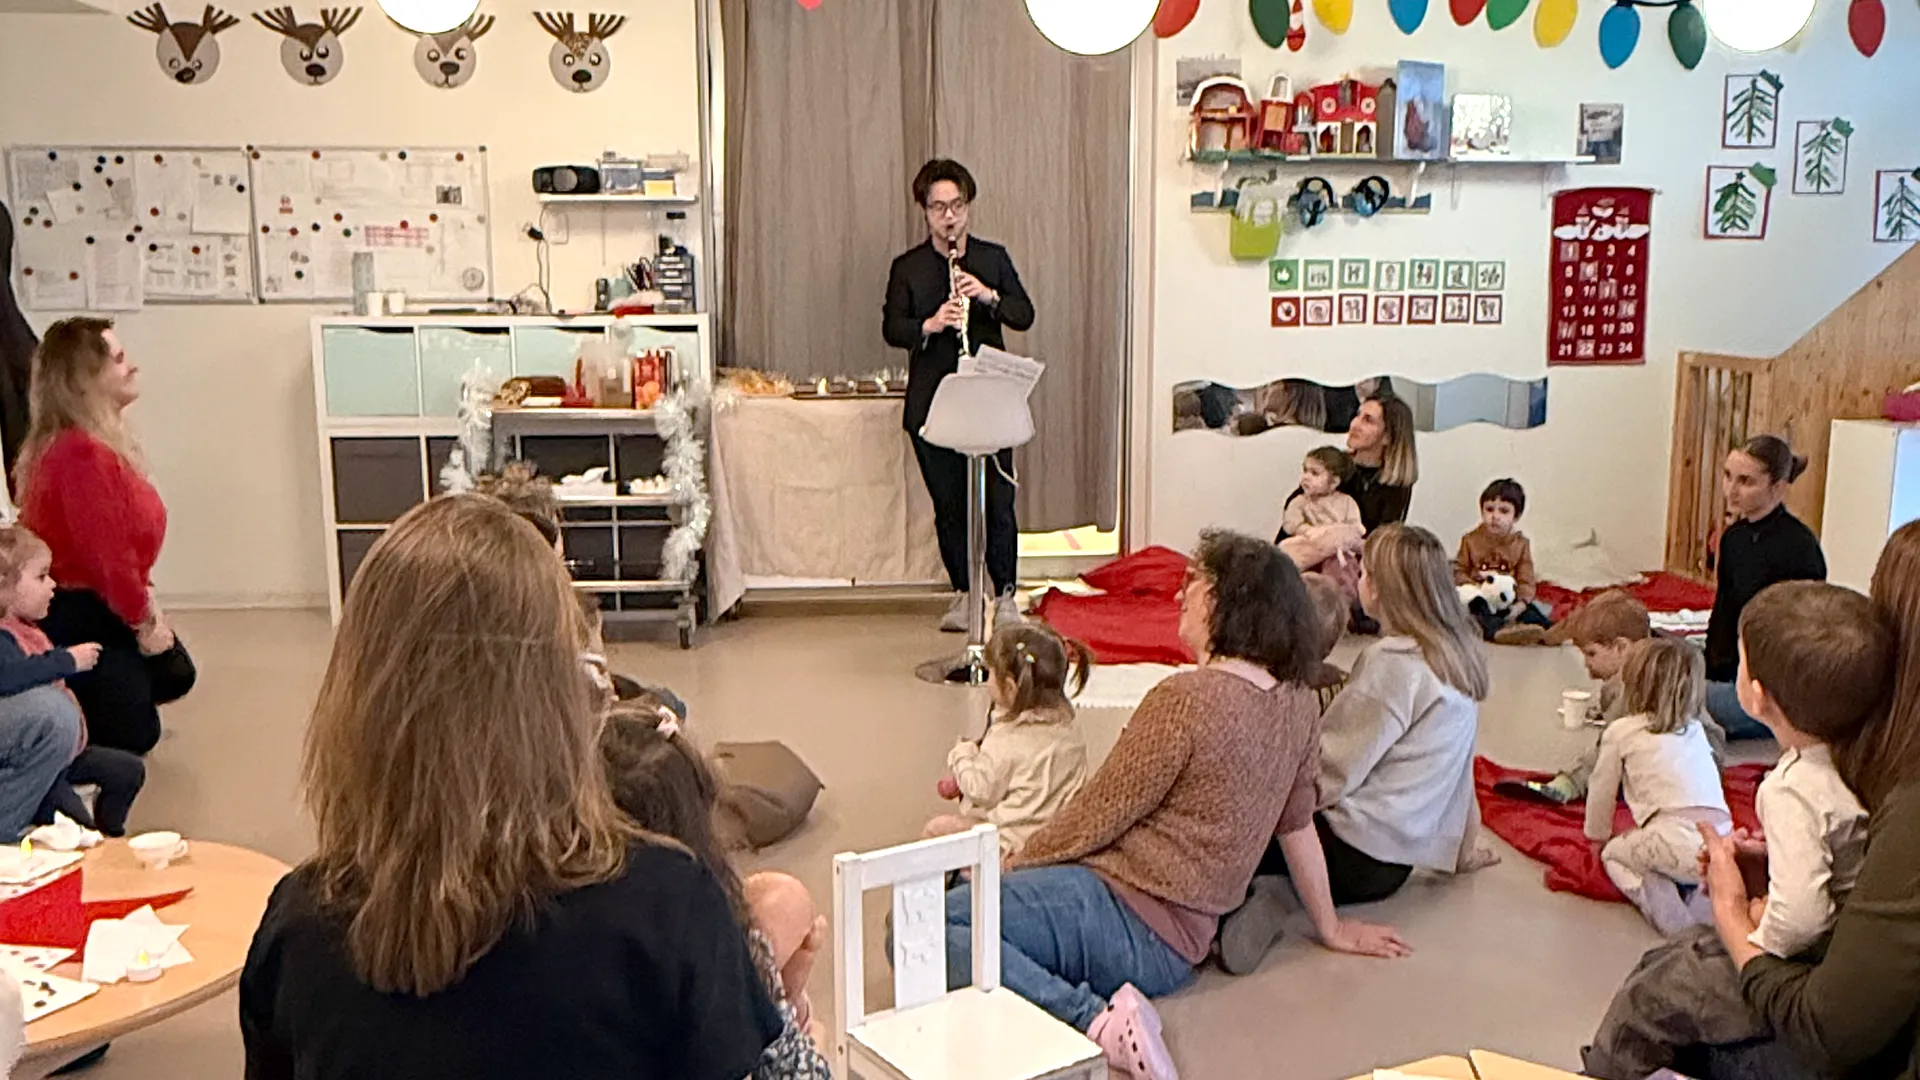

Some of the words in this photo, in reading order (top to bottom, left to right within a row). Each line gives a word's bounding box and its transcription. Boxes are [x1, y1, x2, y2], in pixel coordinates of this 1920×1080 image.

[1585, 244, 1594, 258] 2
[1607, 243, 1615, 257] 3
[1627, 244, 1636, 257] 4
[1606, 264, 1614, 277] 7
[1622, 283, 1636, 297] 12
[1582, 305, 1596, 317] 14
[1558, 343, 1572, 356] 21
[1618, 341, 1633, 354] 24
